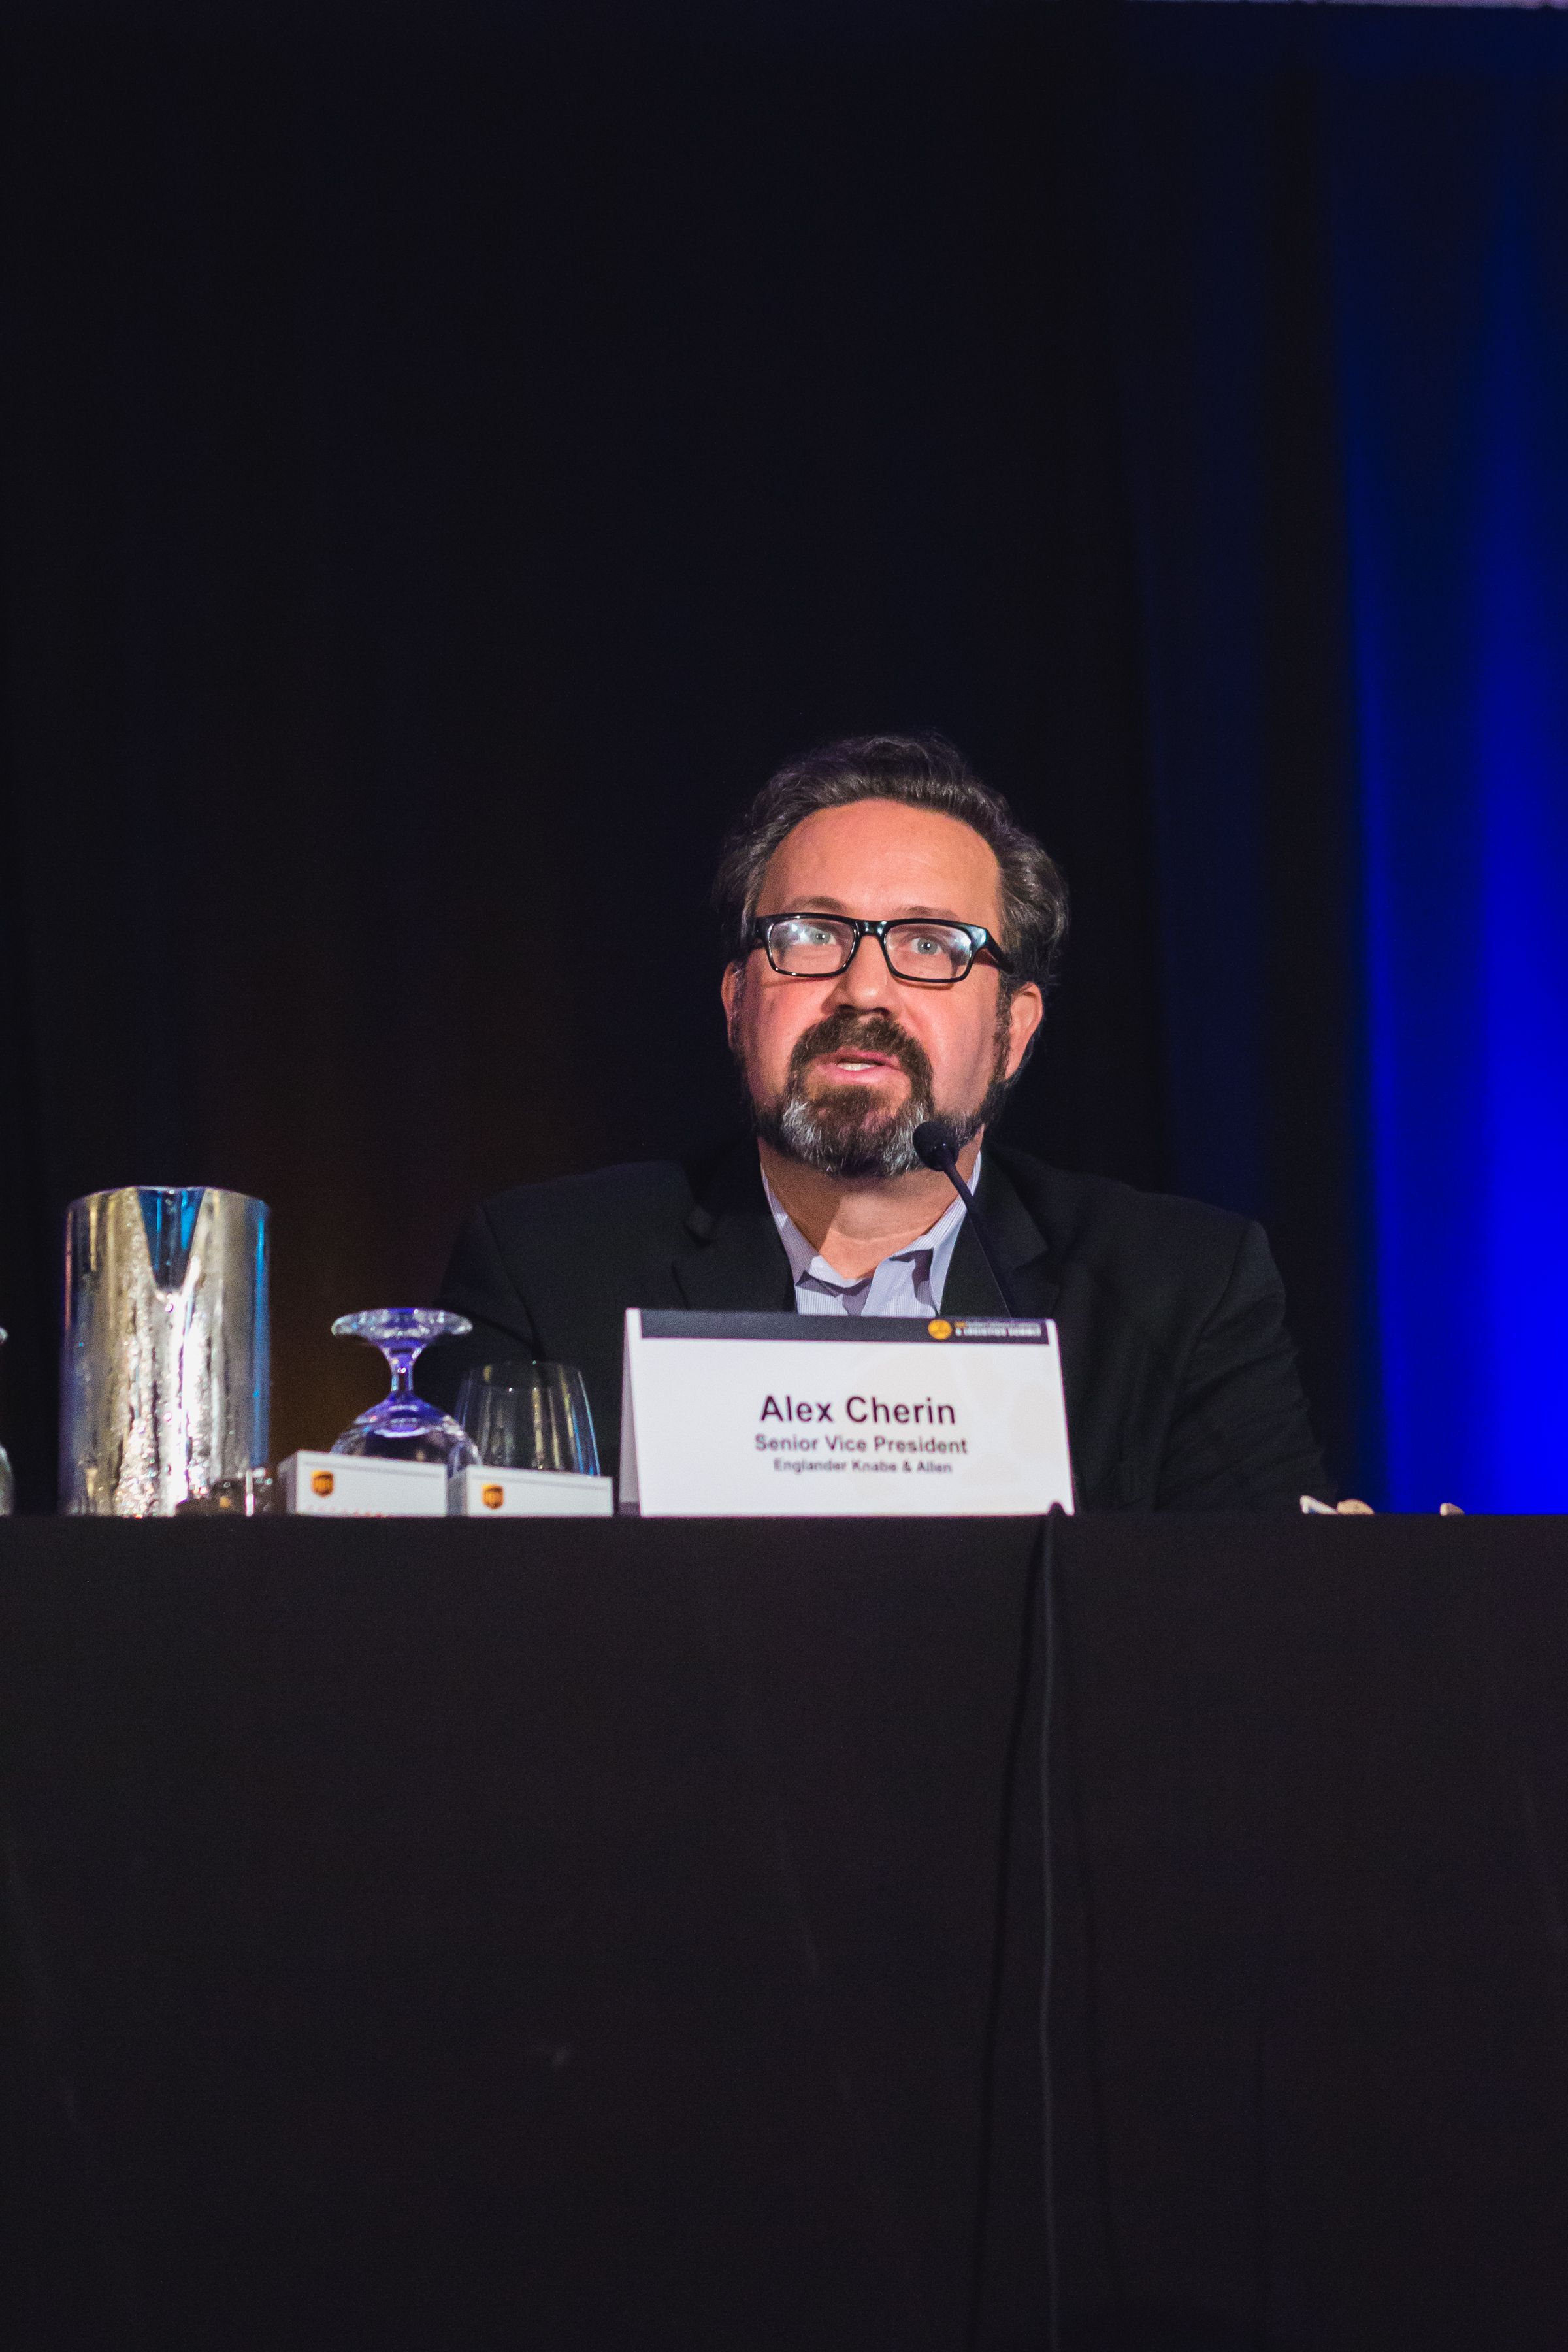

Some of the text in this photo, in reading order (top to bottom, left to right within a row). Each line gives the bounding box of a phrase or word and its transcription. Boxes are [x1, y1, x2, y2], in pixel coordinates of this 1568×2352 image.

[760, 1395, 956, 1425] Alex Cherin
[754, 1434, 968, 1455] Senior Vice President
[773, 1458, 953, 1475] Englander Knabe & Allen
